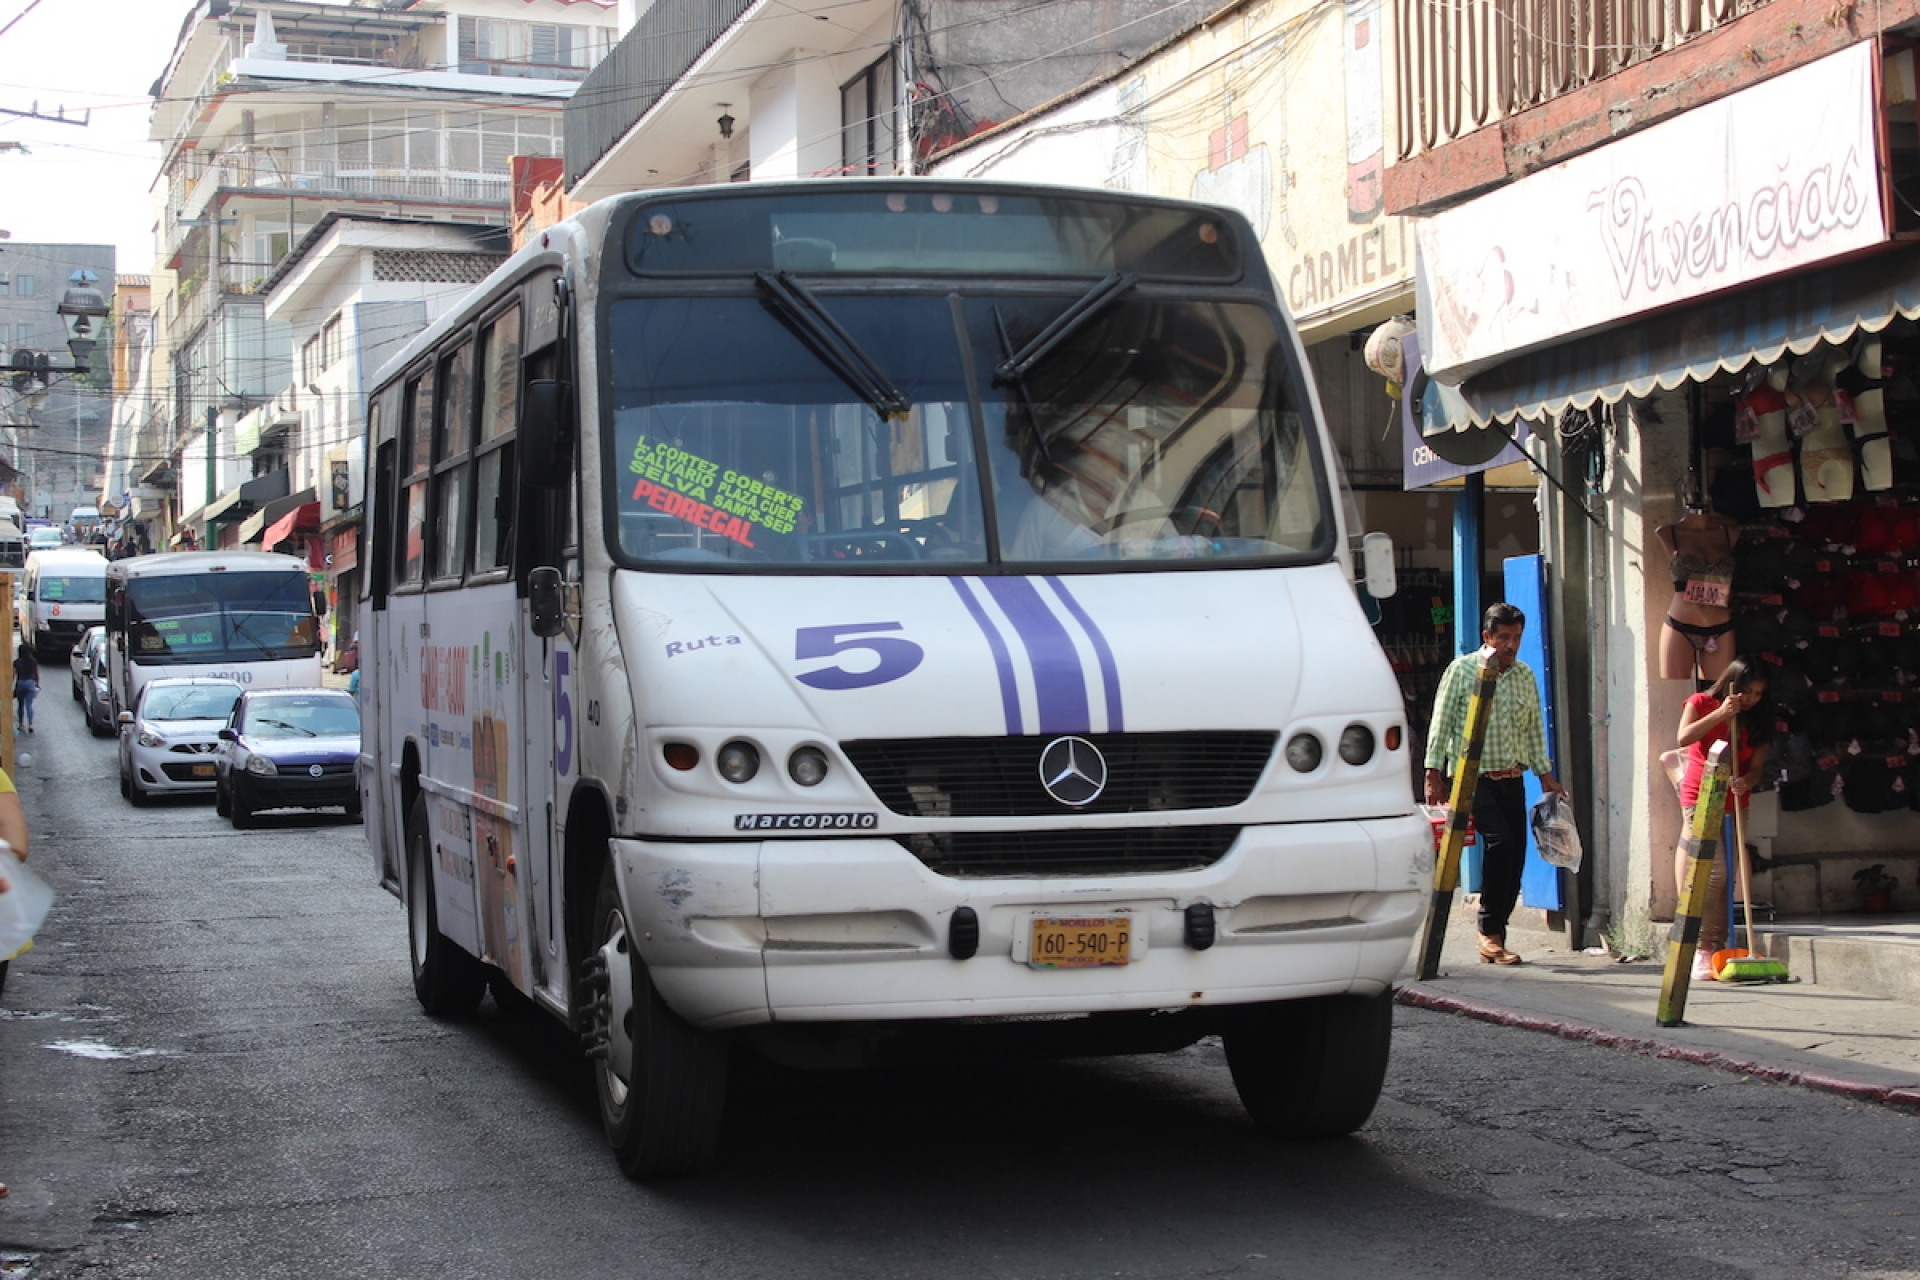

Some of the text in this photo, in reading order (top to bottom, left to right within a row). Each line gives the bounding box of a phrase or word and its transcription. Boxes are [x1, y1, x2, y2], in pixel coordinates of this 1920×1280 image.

[1587, 146, 1867, 300] Vivencias
[1290, 216, 1414, 312] CARMELI
[629, 460, 707, 501] SELVA
[634, 448, 797, 524] CALVARIO PLAZA CUER.
[656, 443, 720, 477] CORTEZ
[723, 470, 803, 511] GOBER'S
[632, 479, 755, 548] PEDREGAL
[665, 634, 742, 658] Ruta
[795, 621, 925, 690] 5
[556, 651, 572, 776] 5
[738, 813, 875, 829] Marcopolo
[1036, 931, 1129, 955] 160-540-P
